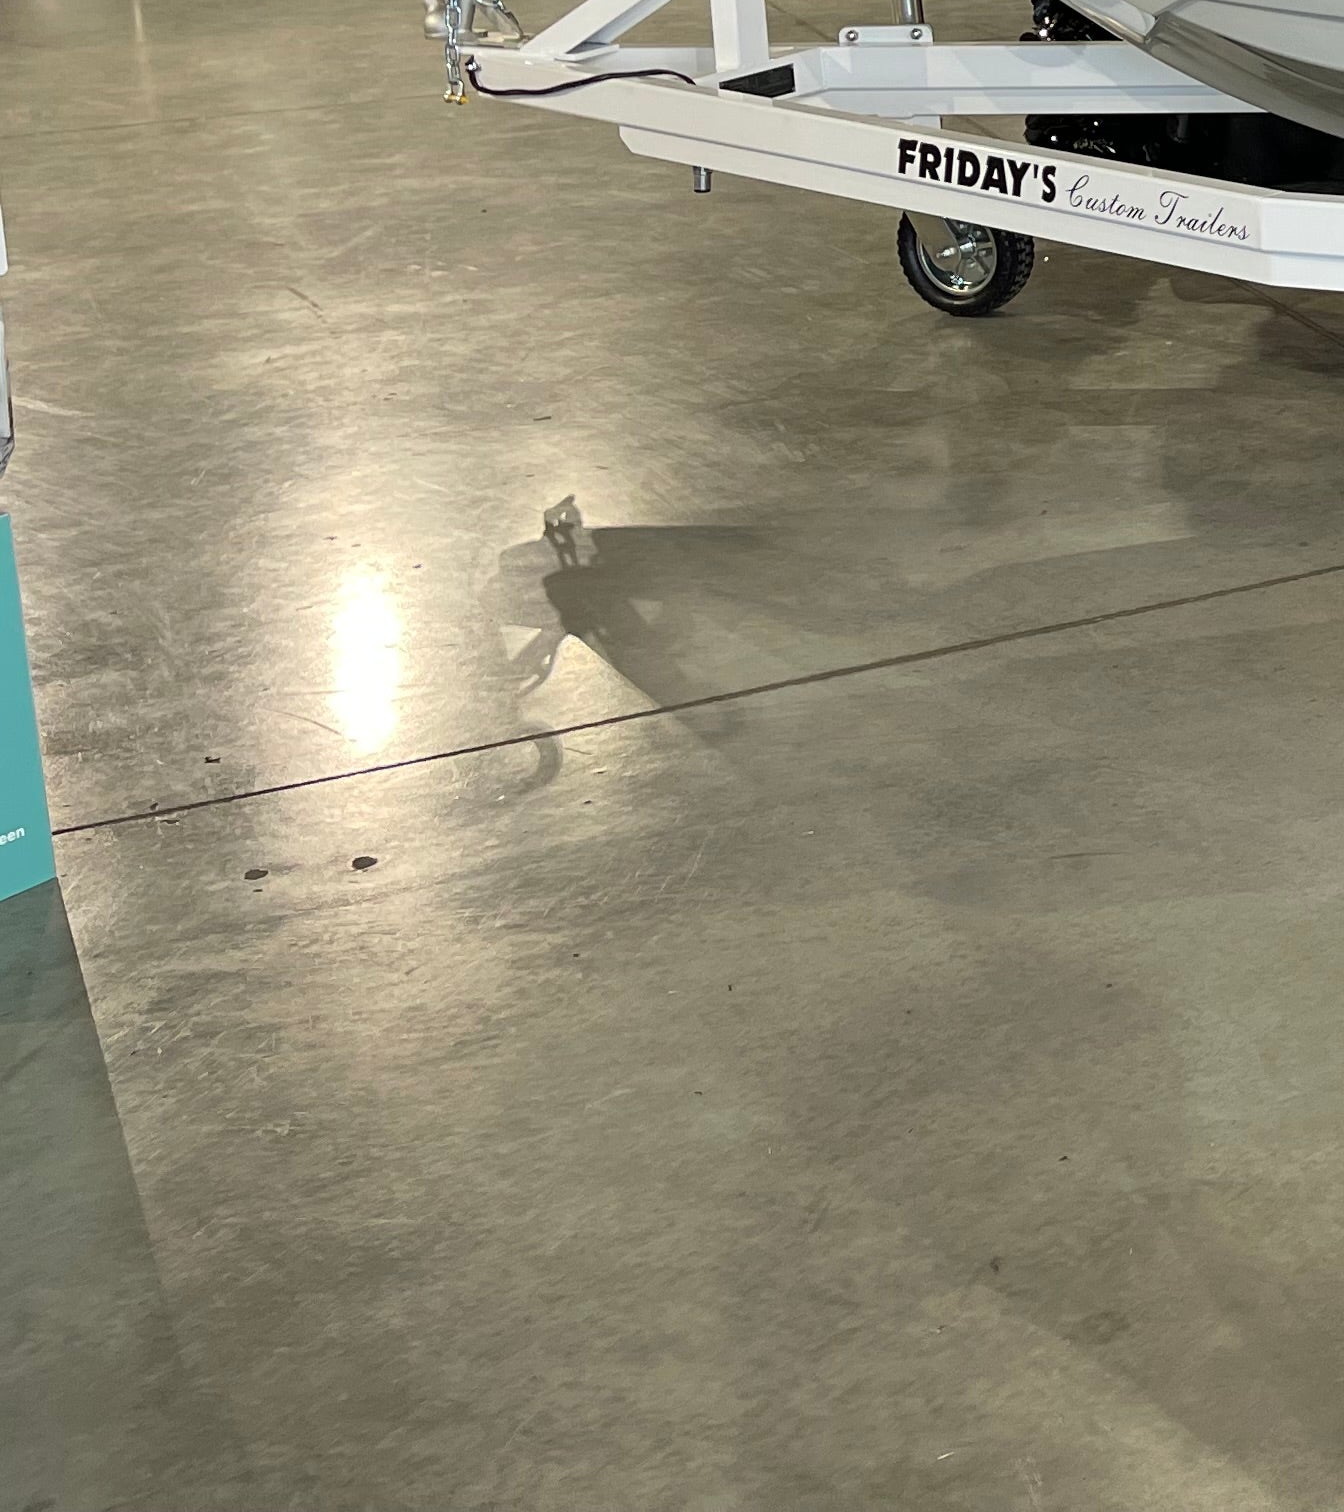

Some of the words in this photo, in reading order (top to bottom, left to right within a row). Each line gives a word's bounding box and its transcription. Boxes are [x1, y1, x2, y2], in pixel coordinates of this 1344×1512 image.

[898, 138, 1058, 203] FRIDAY'S
[1065, 175, 1147, 221] Custom
[1154, 190, 1251, 241] Trailers
